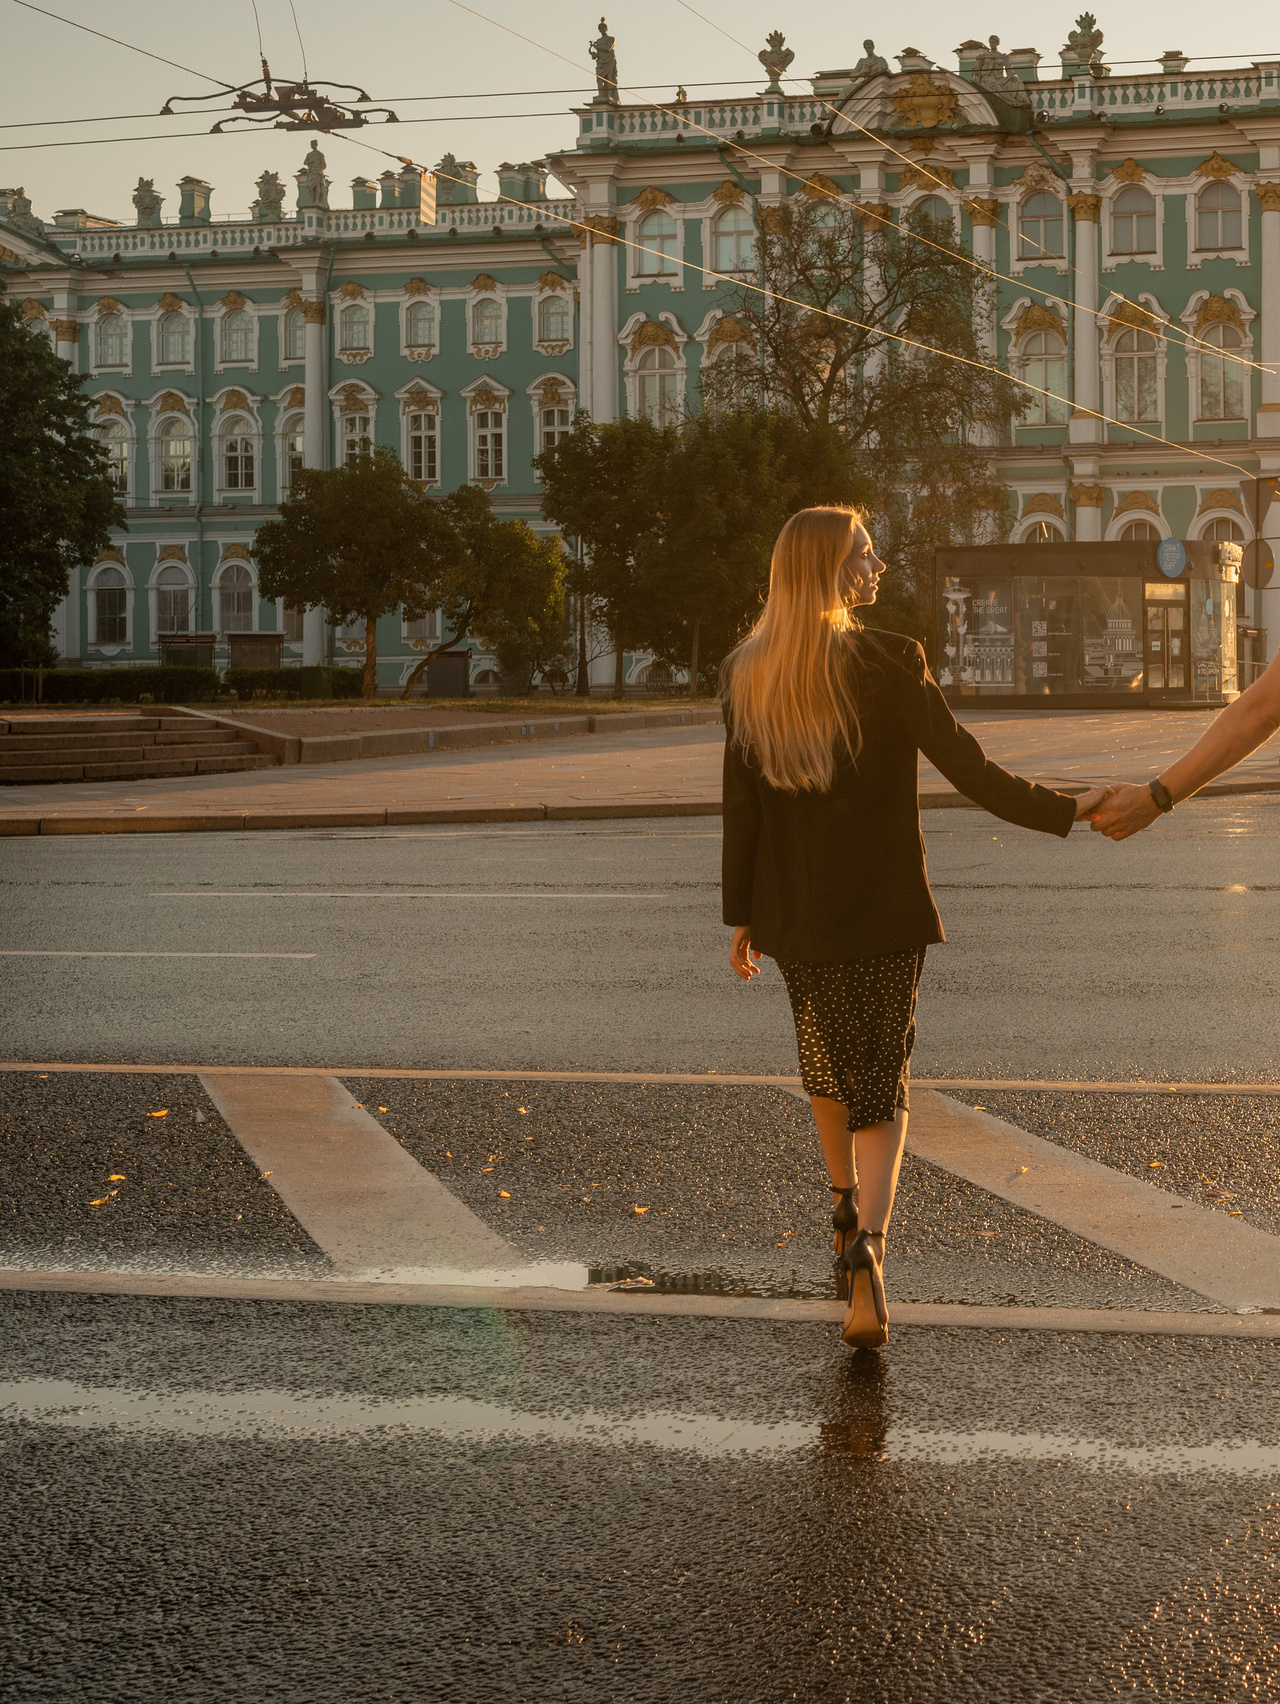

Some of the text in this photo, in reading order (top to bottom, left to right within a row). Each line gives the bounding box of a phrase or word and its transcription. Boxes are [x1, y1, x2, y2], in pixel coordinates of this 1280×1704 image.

[1164, 544, 1180, 552] САНКТ
[1164, 553, 1180, 561] ПЕТЕР
[1164, 562, 1177, 570] БУРГ
